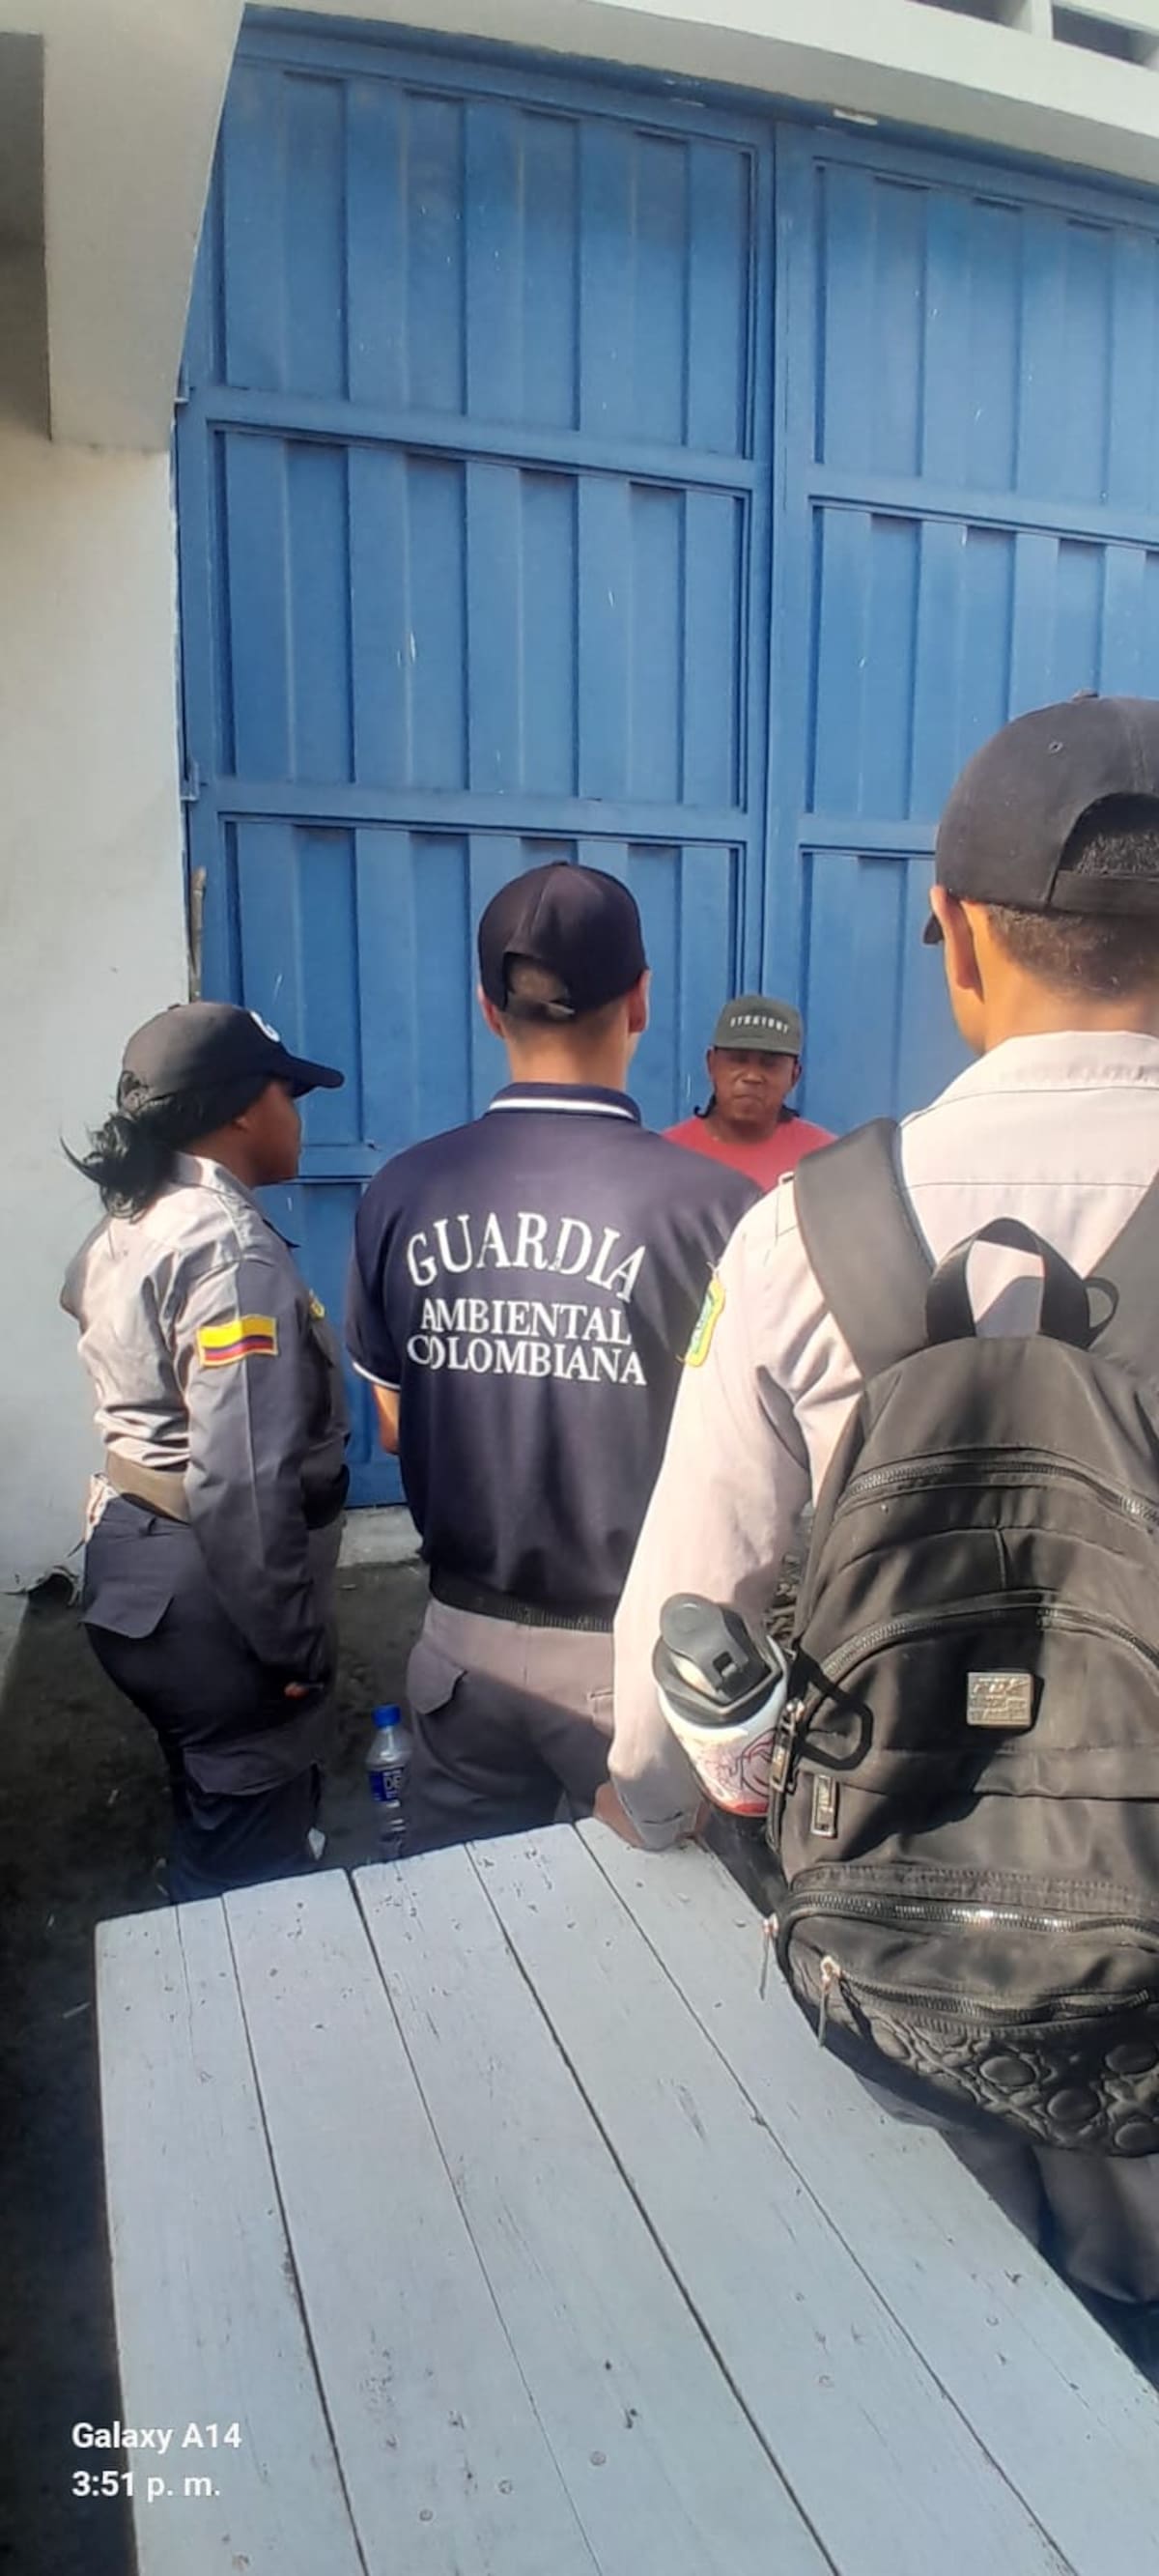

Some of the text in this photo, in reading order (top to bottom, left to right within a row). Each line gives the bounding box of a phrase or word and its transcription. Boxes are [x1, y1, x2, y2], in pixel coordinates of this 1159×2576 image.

[407, 1211, 646, 1303] GUARDIA
[420, 1297, 633, 1345] AMBIENTAL
[407, 1334, 648, 1386] COLOMBIANA
